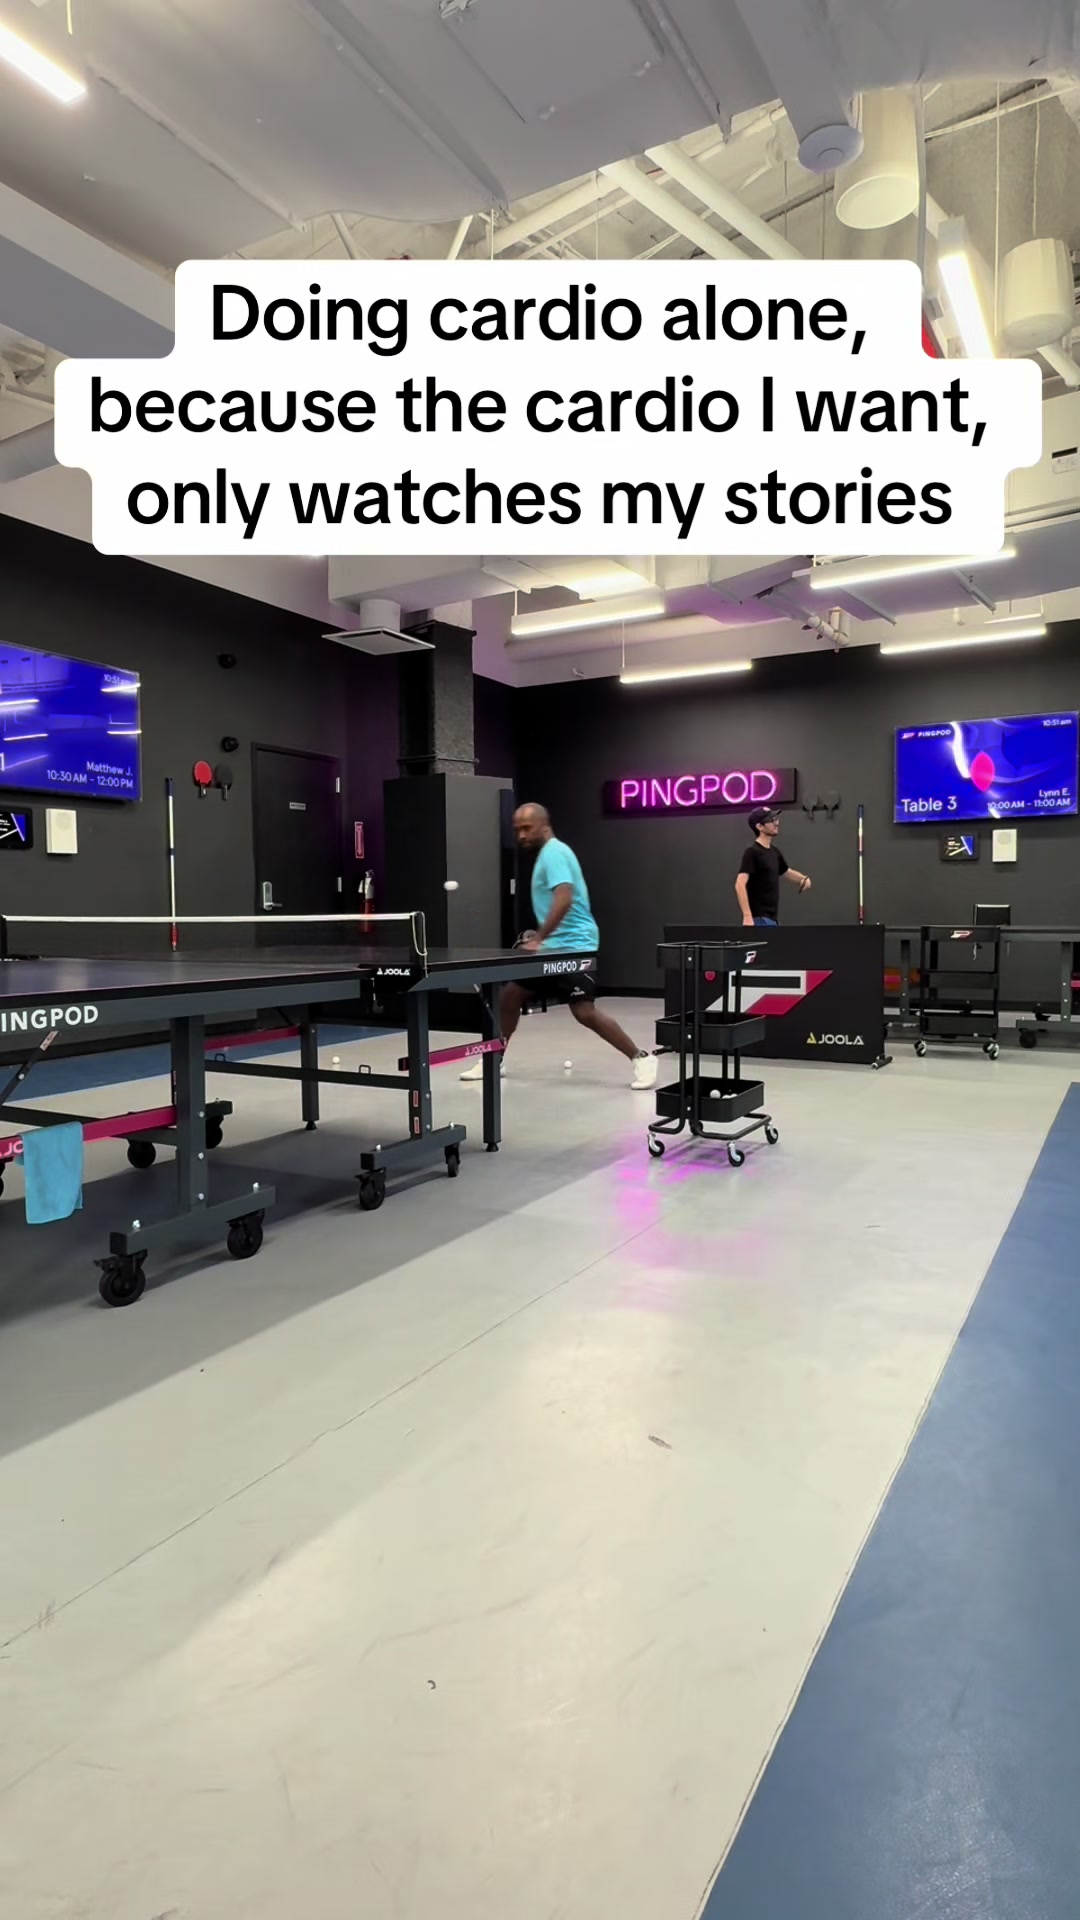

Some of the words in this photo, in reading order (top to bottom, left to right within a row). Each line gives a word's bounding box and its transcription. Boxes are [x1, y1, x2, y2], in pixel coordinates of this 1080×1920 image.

[918, 729, 952, 738] PINGPOD
[86, 761, 124, 775] Matthew
[126, 766, 134, 777] J.
[47, 769, 72, 782] 10:30
[73, 773, 88, 784] AM
[97, 775, 119, 787] 12:00
[120, 778, 134, 789] PM
[621, 770, 777, 808] PINGPOD
[1039, 789, 1060, 798] Lynn
[901, 797, 943, 812] Table
[947, 796, 957, 810] 3
[987, 801, 1010, 810] 10:00
[1011, 800, 1025, 808] AM
[1034, 798, 1055, 807] 11:00
[1056, 797, 1070, 806] AM
[384, 968, 411, 976] JOOLA
[543, 960, 577, 974] PINGPOD
[818, 1032, 865, 1045] JOOLA
[470, 1043, 492, 1055] JOOLA
